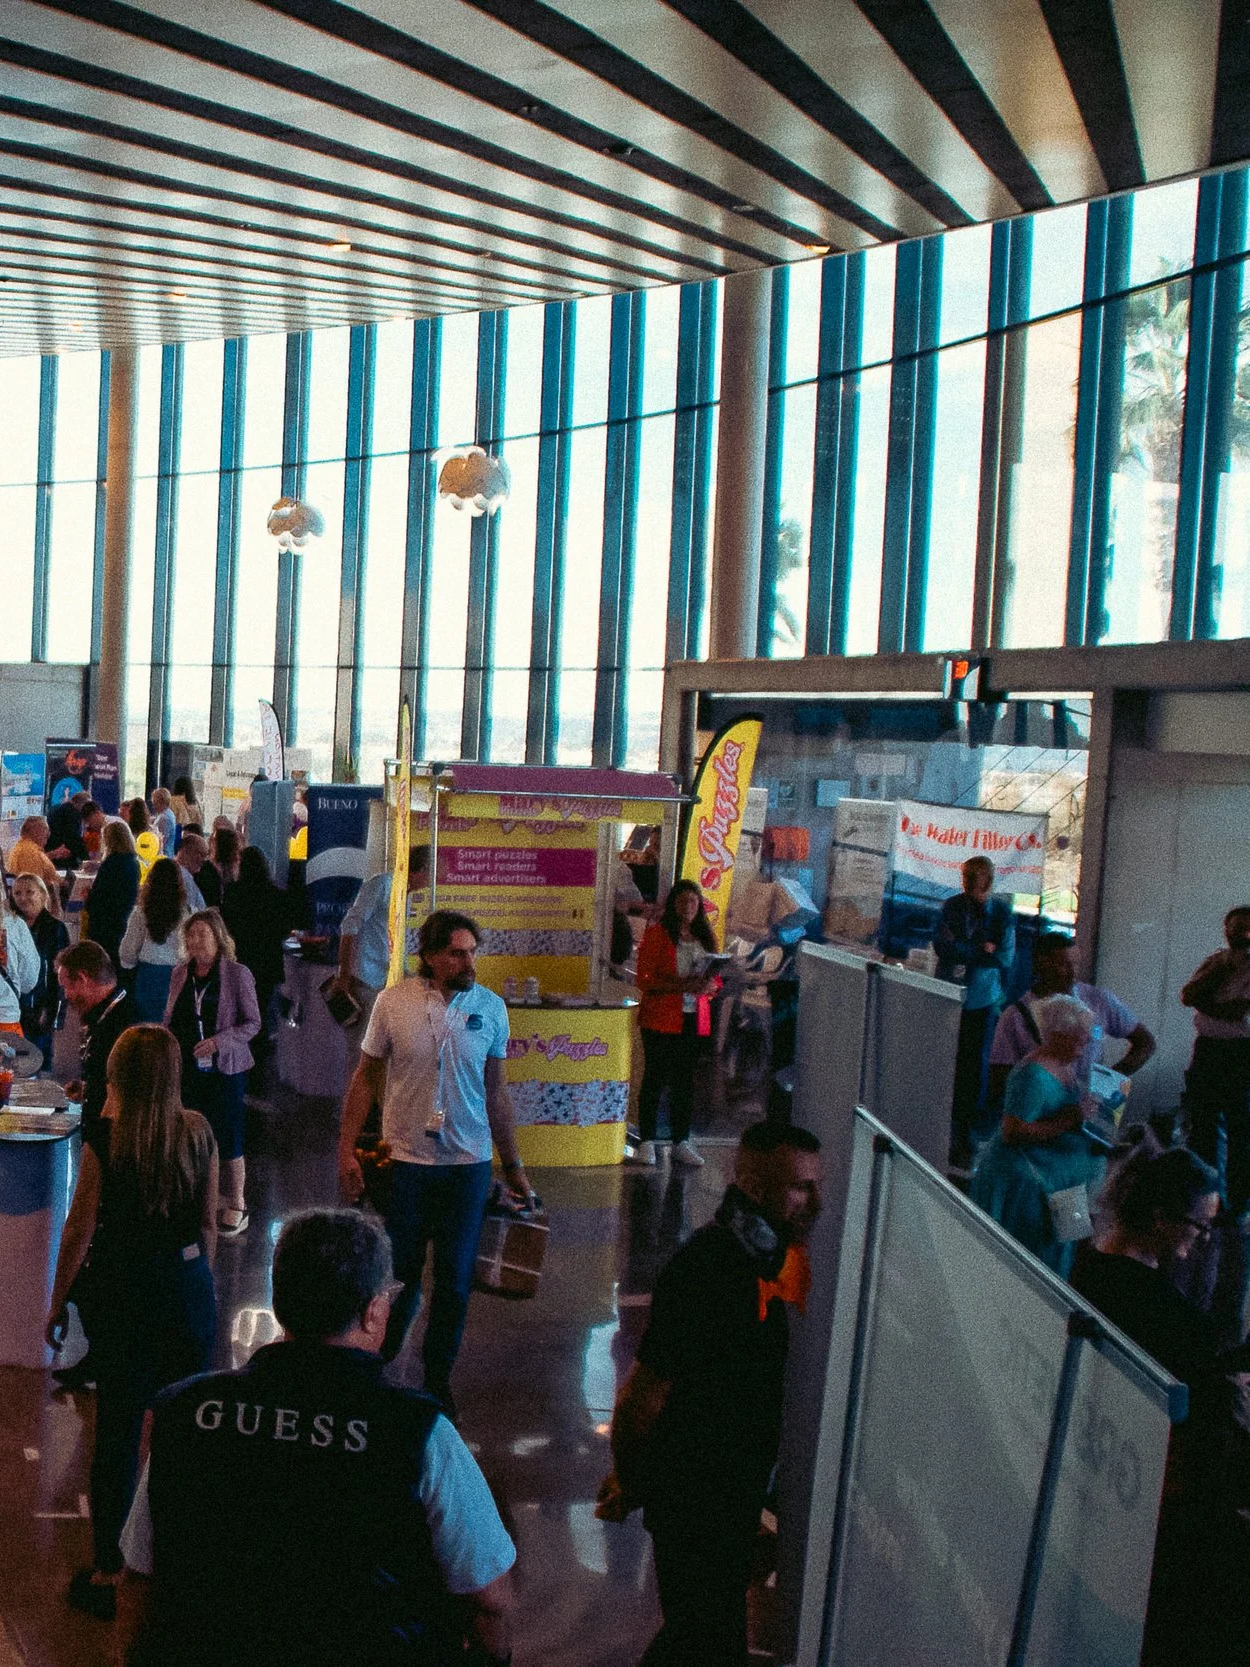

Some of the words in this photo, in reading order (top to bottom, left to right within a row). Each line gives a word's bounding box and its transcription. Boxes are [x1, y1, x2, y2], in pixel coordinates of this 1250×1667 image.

[699, 740, 745, 872] Puzzles
[458, 849, 491, 859] Smart
[458, 861, 491, 871] Smart
[446, 873, 480, 883] Smart
[195, 1400, 369, 1453] GUESS
